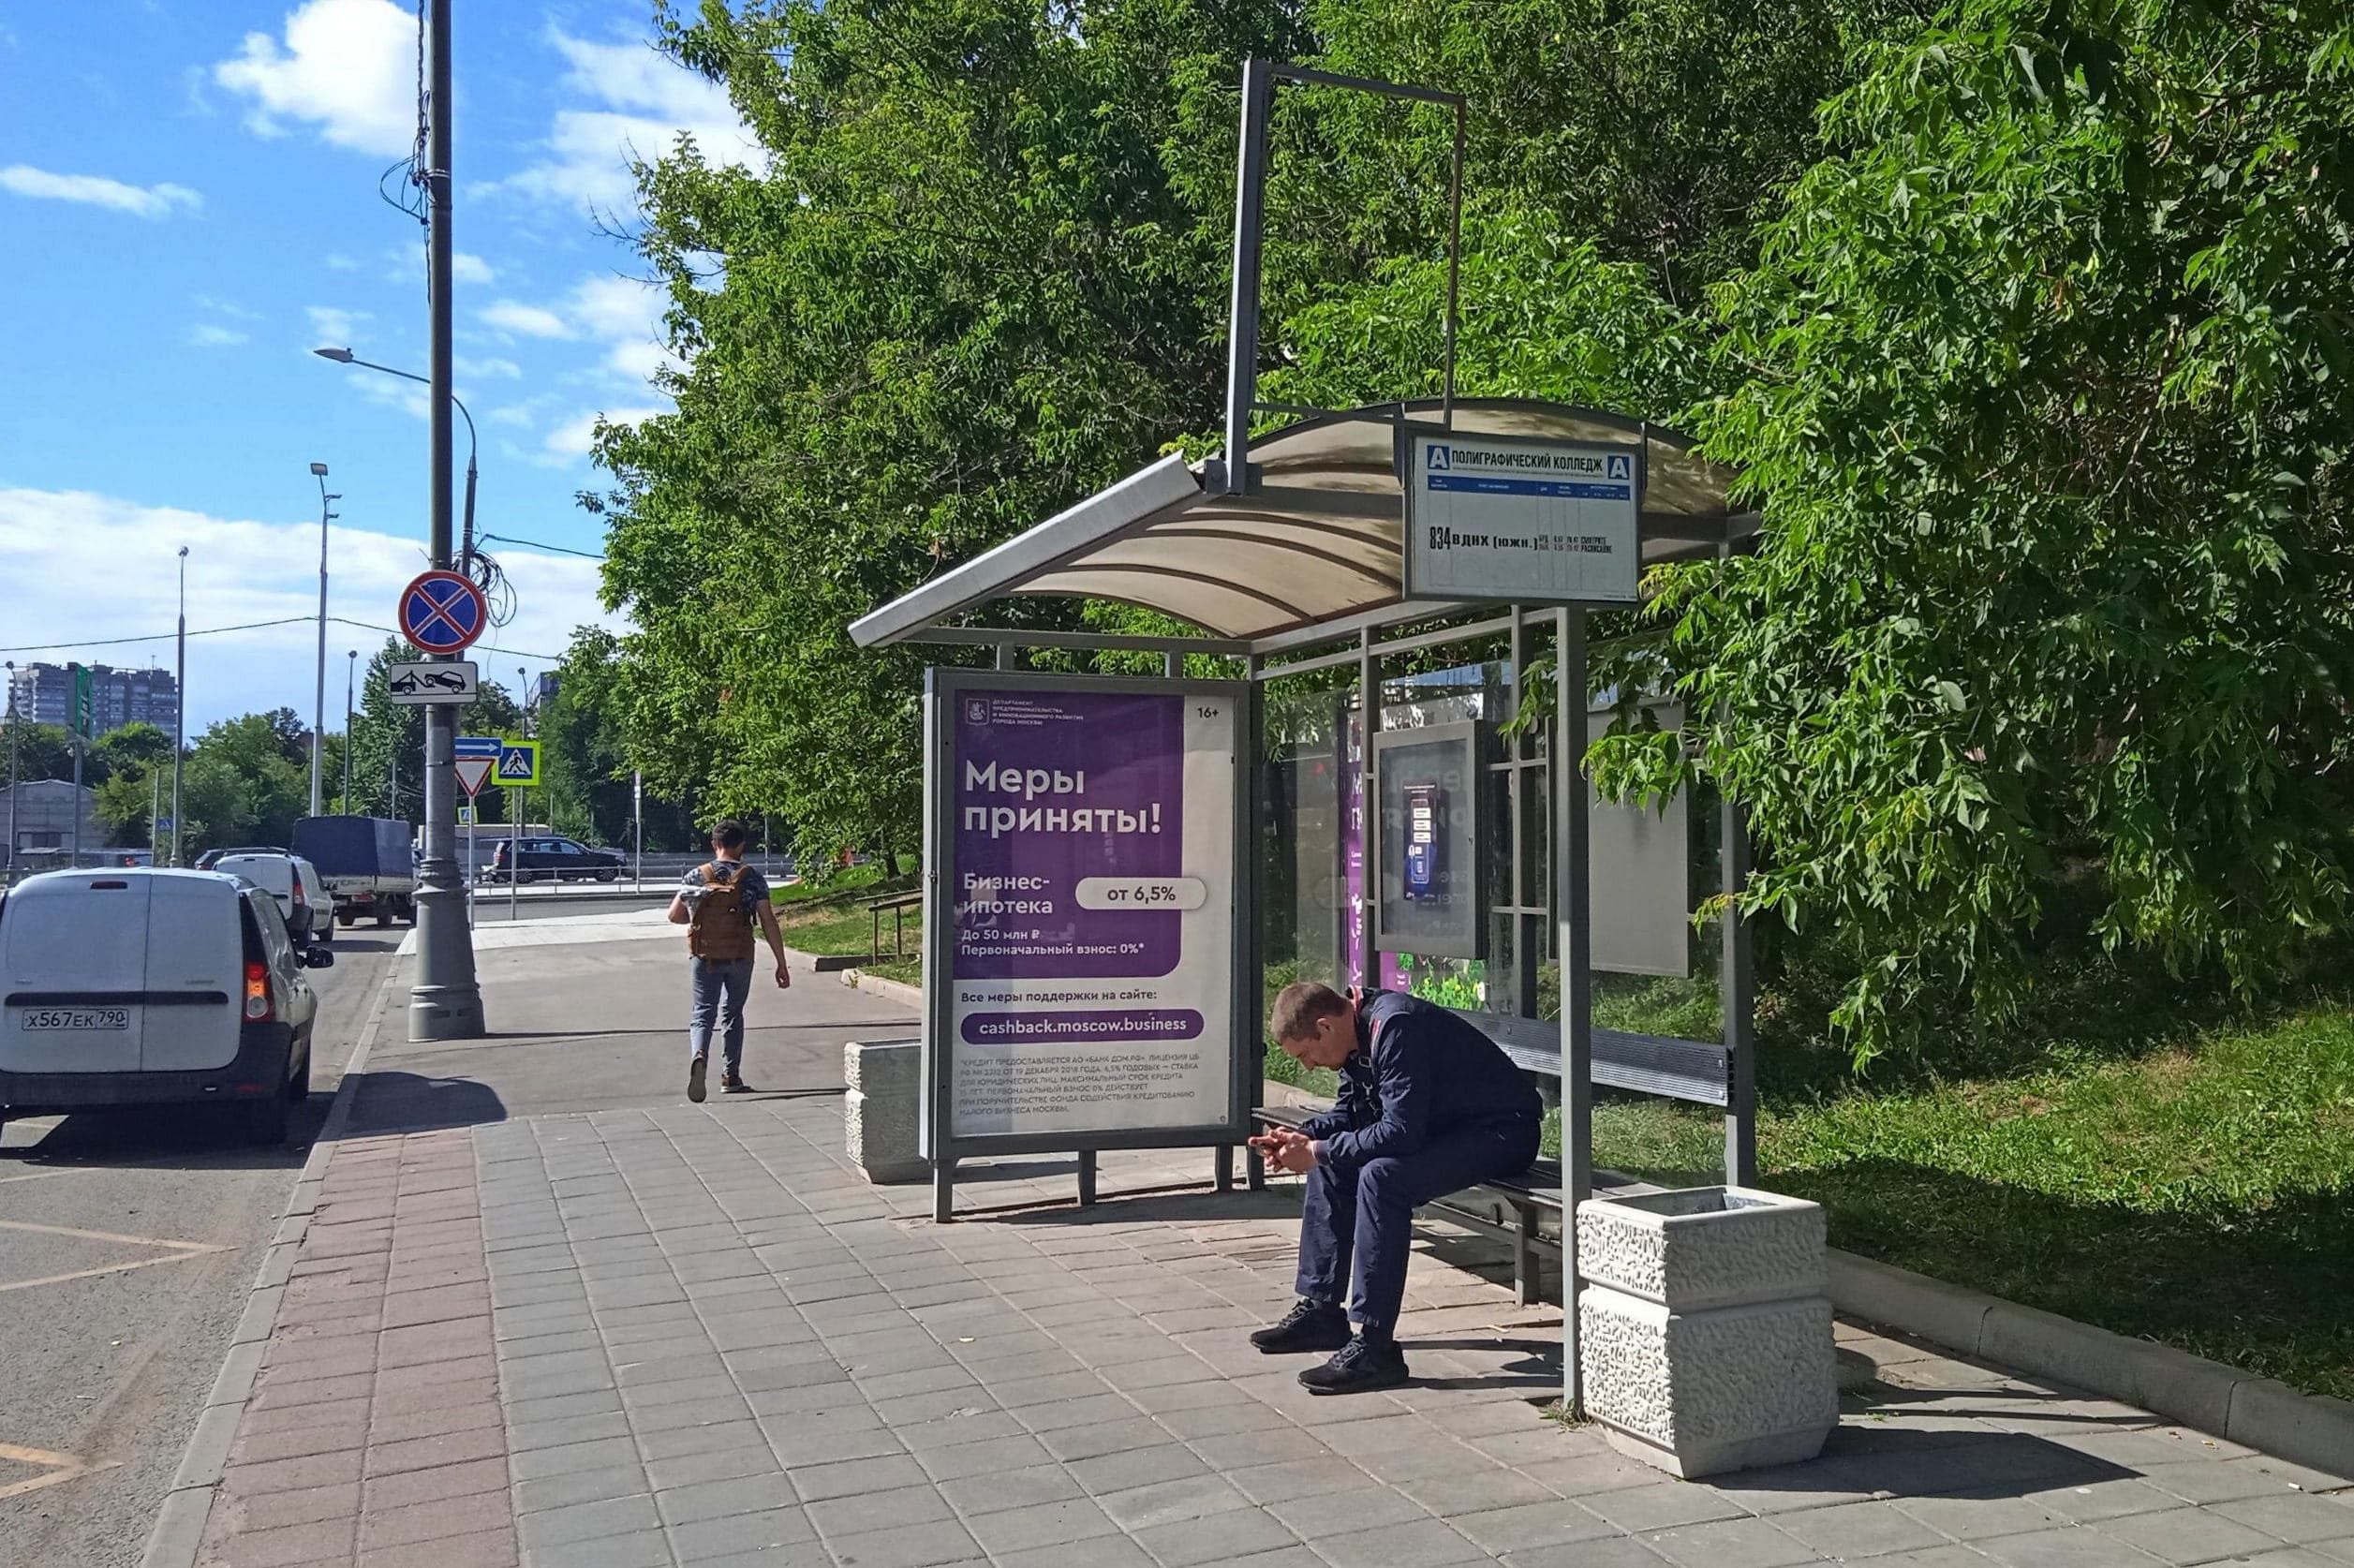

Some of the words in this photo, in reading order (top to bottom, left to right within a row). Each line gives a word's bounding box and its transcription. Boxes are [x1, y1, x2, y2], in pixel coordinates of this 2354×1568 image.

[1452, 450, 1551, 469] ПОЛИГРАФИЧЕСКИЙ
[1553, 456, 1603, 472] КОЛЛЕДЖ
[1429, 526, 1451, 551] 834
[1197, 707, 1219, 718] 16+
[965, 760, 1085, 801] Меры
[964, 803, 1162, 839] приняты!
[963, 872, 1050, 891] Бизнес-
[1107, 888, 1128, 901] от
[1133, 886, 1177, 906] 6,5%
[963, 899, 1054, 916] ипотека
[961, 929, 980, 942] До
[983, 928, 999, 940] 50
[1003, 930, 1029, 940] млн
[961, 942, 1073, 959] Первоначальный
[1077, 944, 1117, 955] взнос:
[961, 993, 984, 1003] Все
[987, 993, 1023, 1005] меры
[1027, 990, 1099, 1004] поддержки
[1103, 991, 1116, 1001] на
[1119, 988, 1158, 1001] сайте:
[979, 1016, 1187, 1035] cashback.moscow.business
